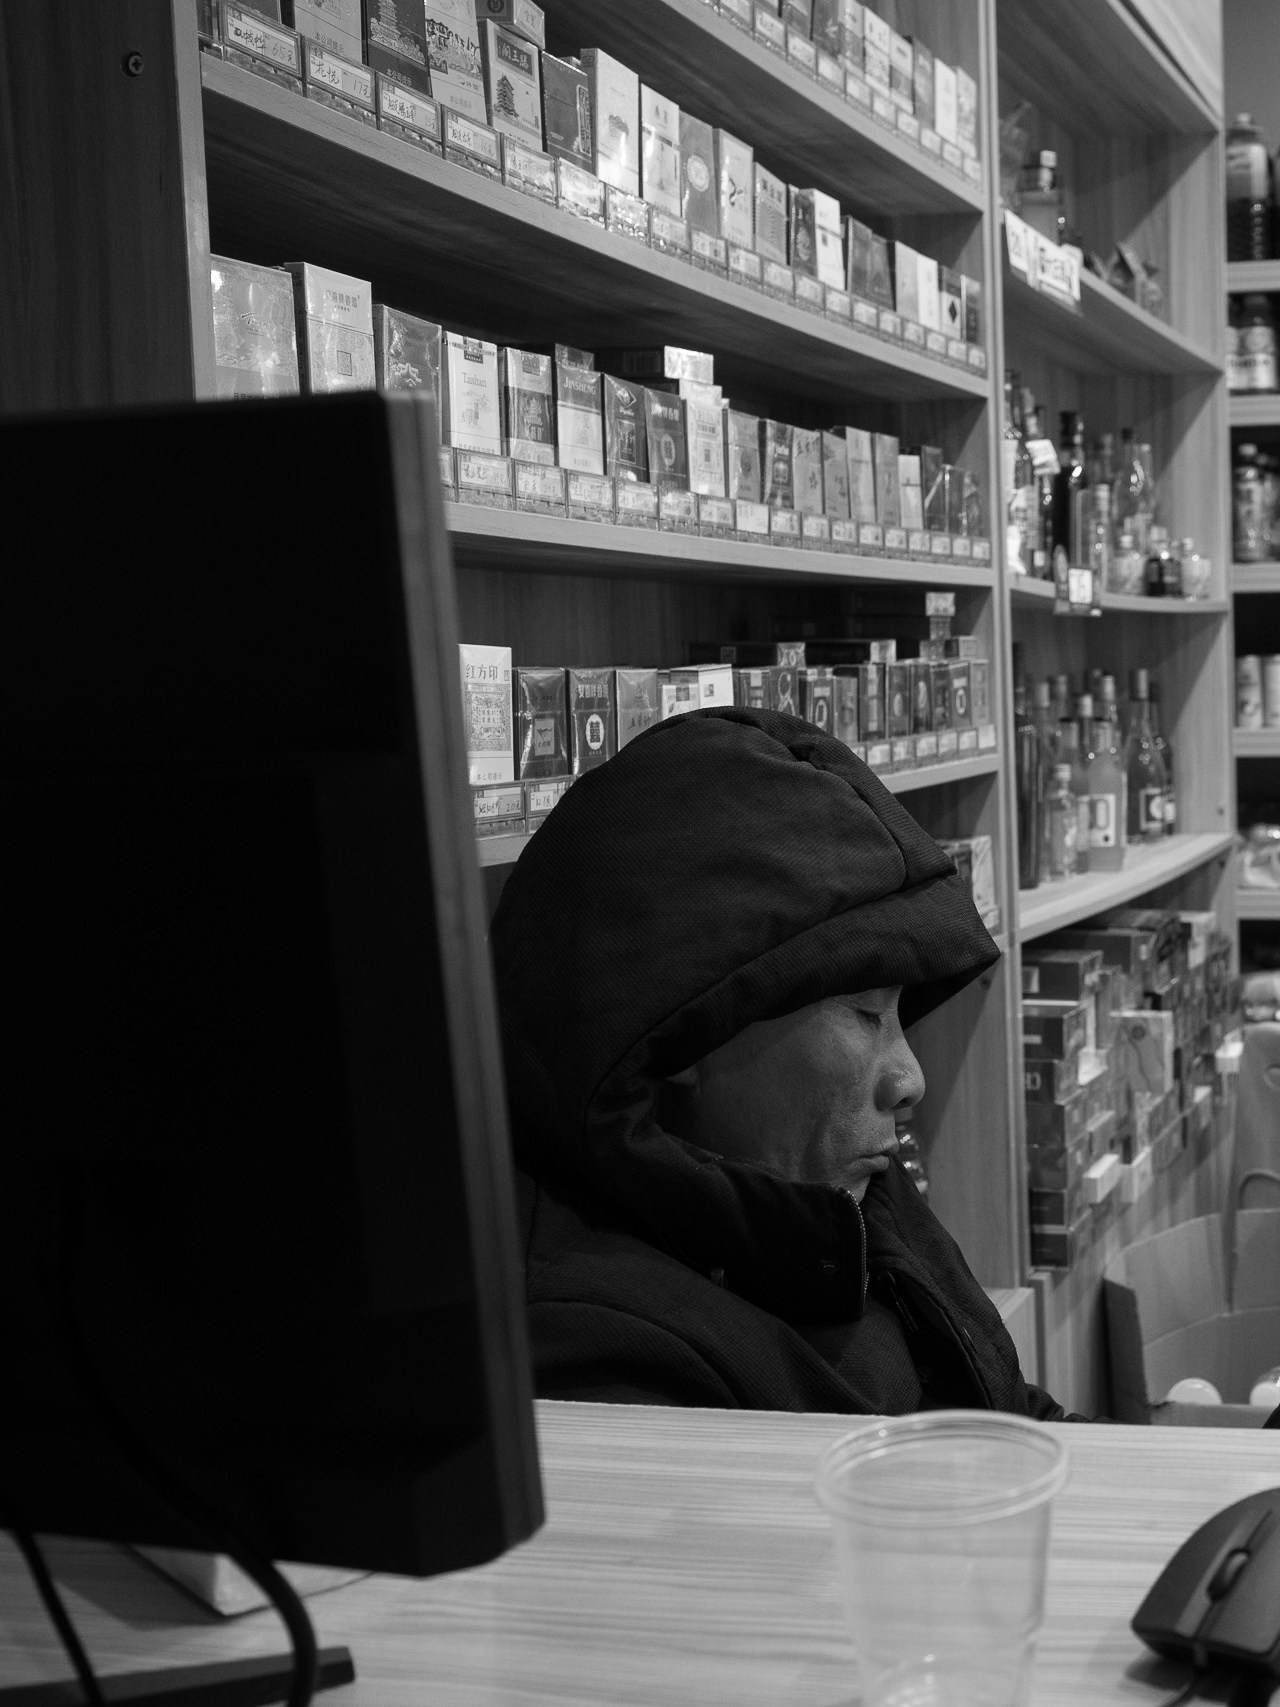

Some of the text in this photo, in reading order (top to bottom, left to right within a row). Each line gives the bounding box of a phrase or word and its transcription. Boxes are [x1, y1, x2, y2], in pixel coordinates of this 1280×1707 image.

[462, 372, 487, 388] Taishan
[466, 664, 499, 681] 红方印
